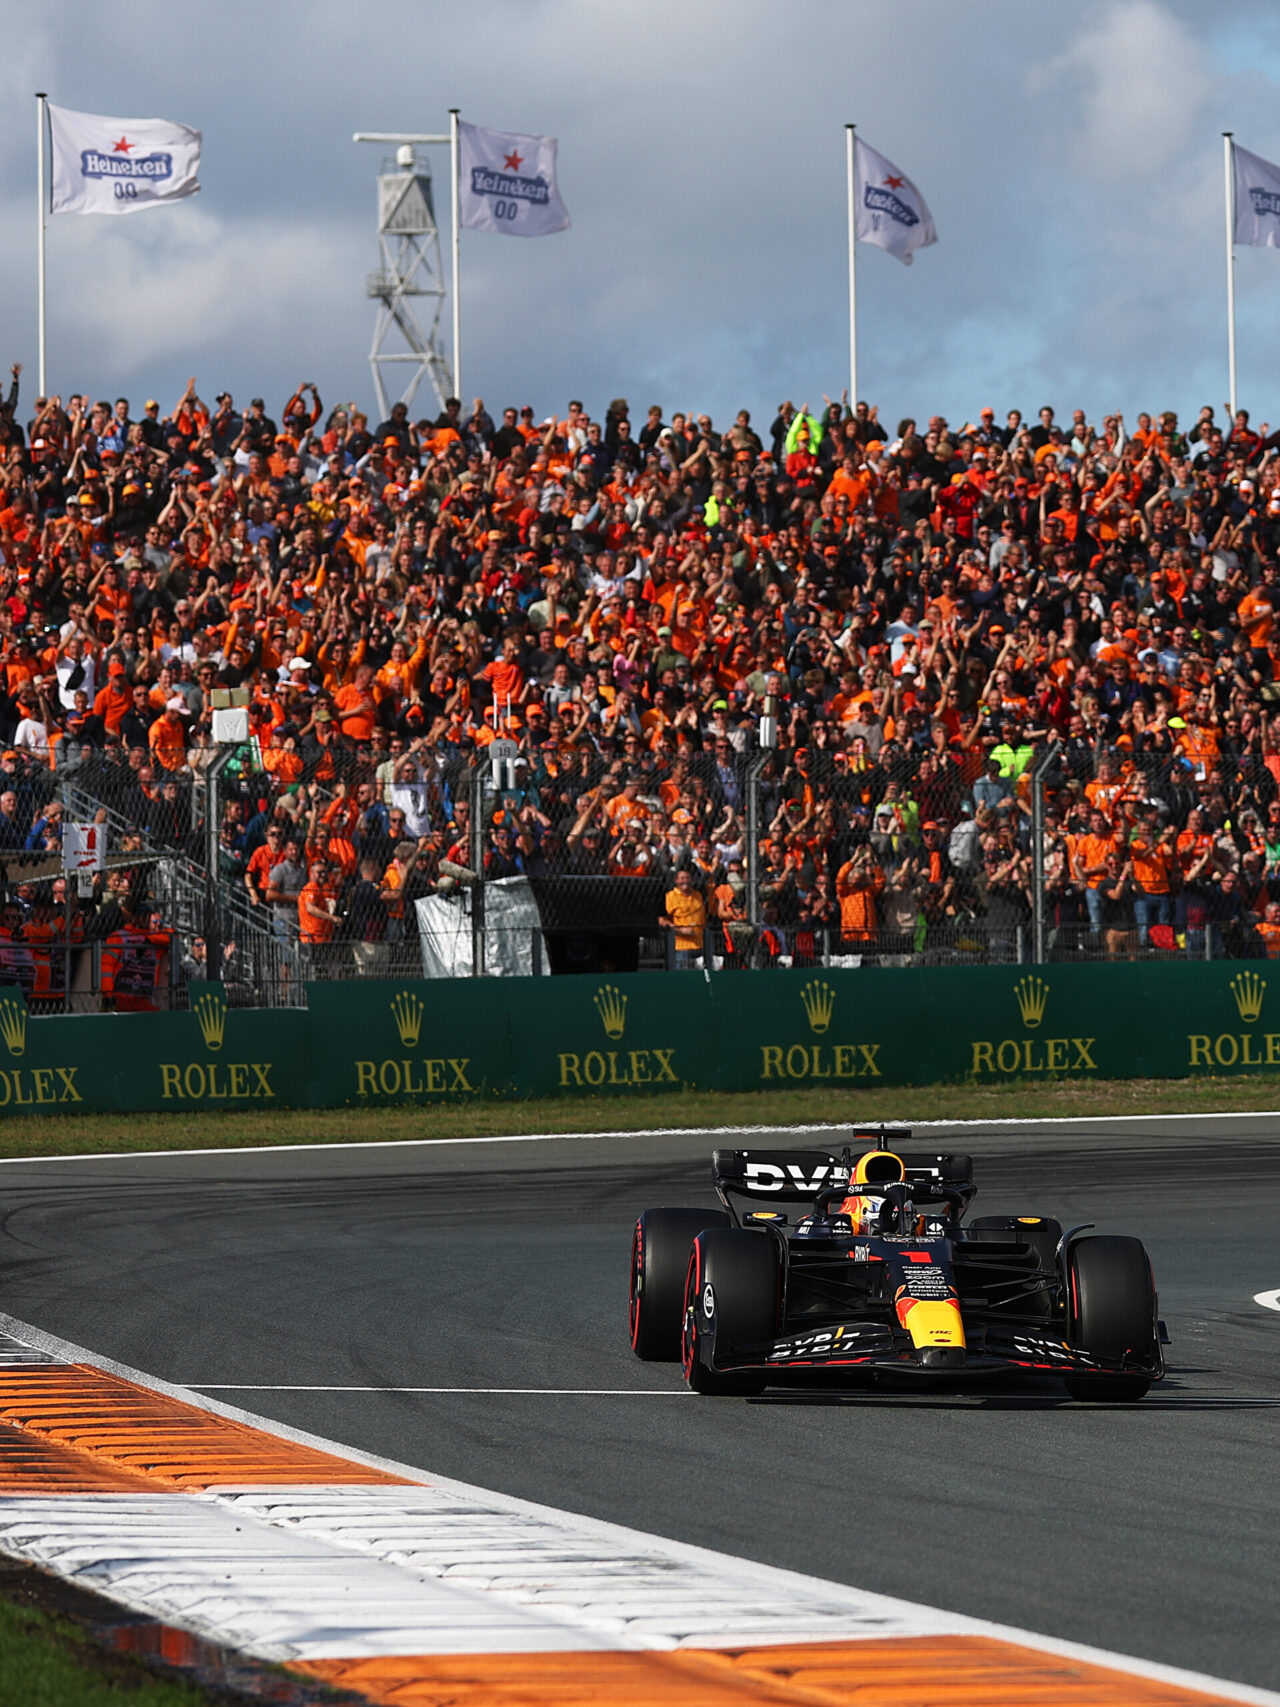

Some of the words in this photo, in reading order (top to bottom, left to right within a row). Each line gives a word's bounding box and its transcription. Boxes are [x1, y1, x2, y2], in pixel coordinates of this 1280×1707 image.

[86, 154, 168, 176] Heineken
[474, 171, 547, 200] Heineken
[559, 1049, 679, 1086] ROLEX
[761, 1044, 881, 1079] ROLEX
[972, 1038, 1098, 1073] ROLEX
[160, 1063, 275, 1099] ROLEX
[357, 1058, 473, 1095] ROLEX
[898, 1251, 932, 1263] 1
